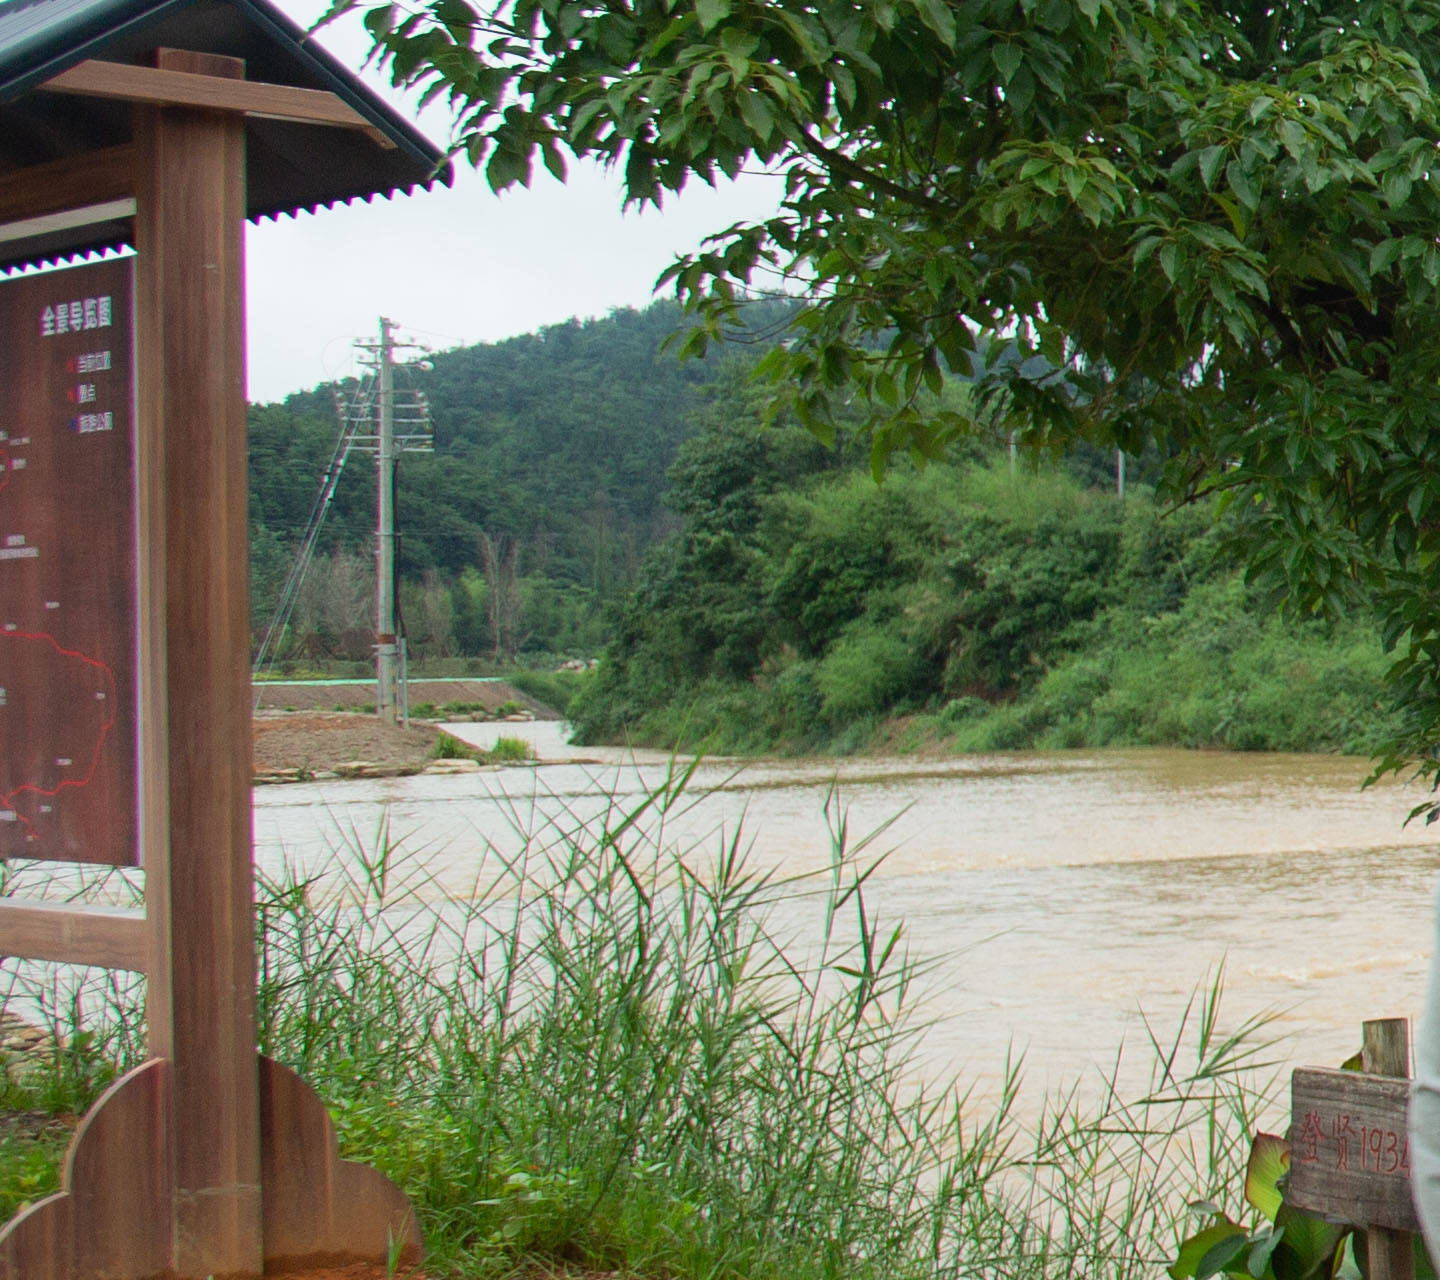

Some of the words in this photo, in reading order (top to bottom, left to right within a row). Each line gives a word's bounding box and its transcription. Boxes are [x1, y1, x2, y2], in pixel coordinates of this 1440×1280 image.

[41, 296, 112, 336] 全景导览图
